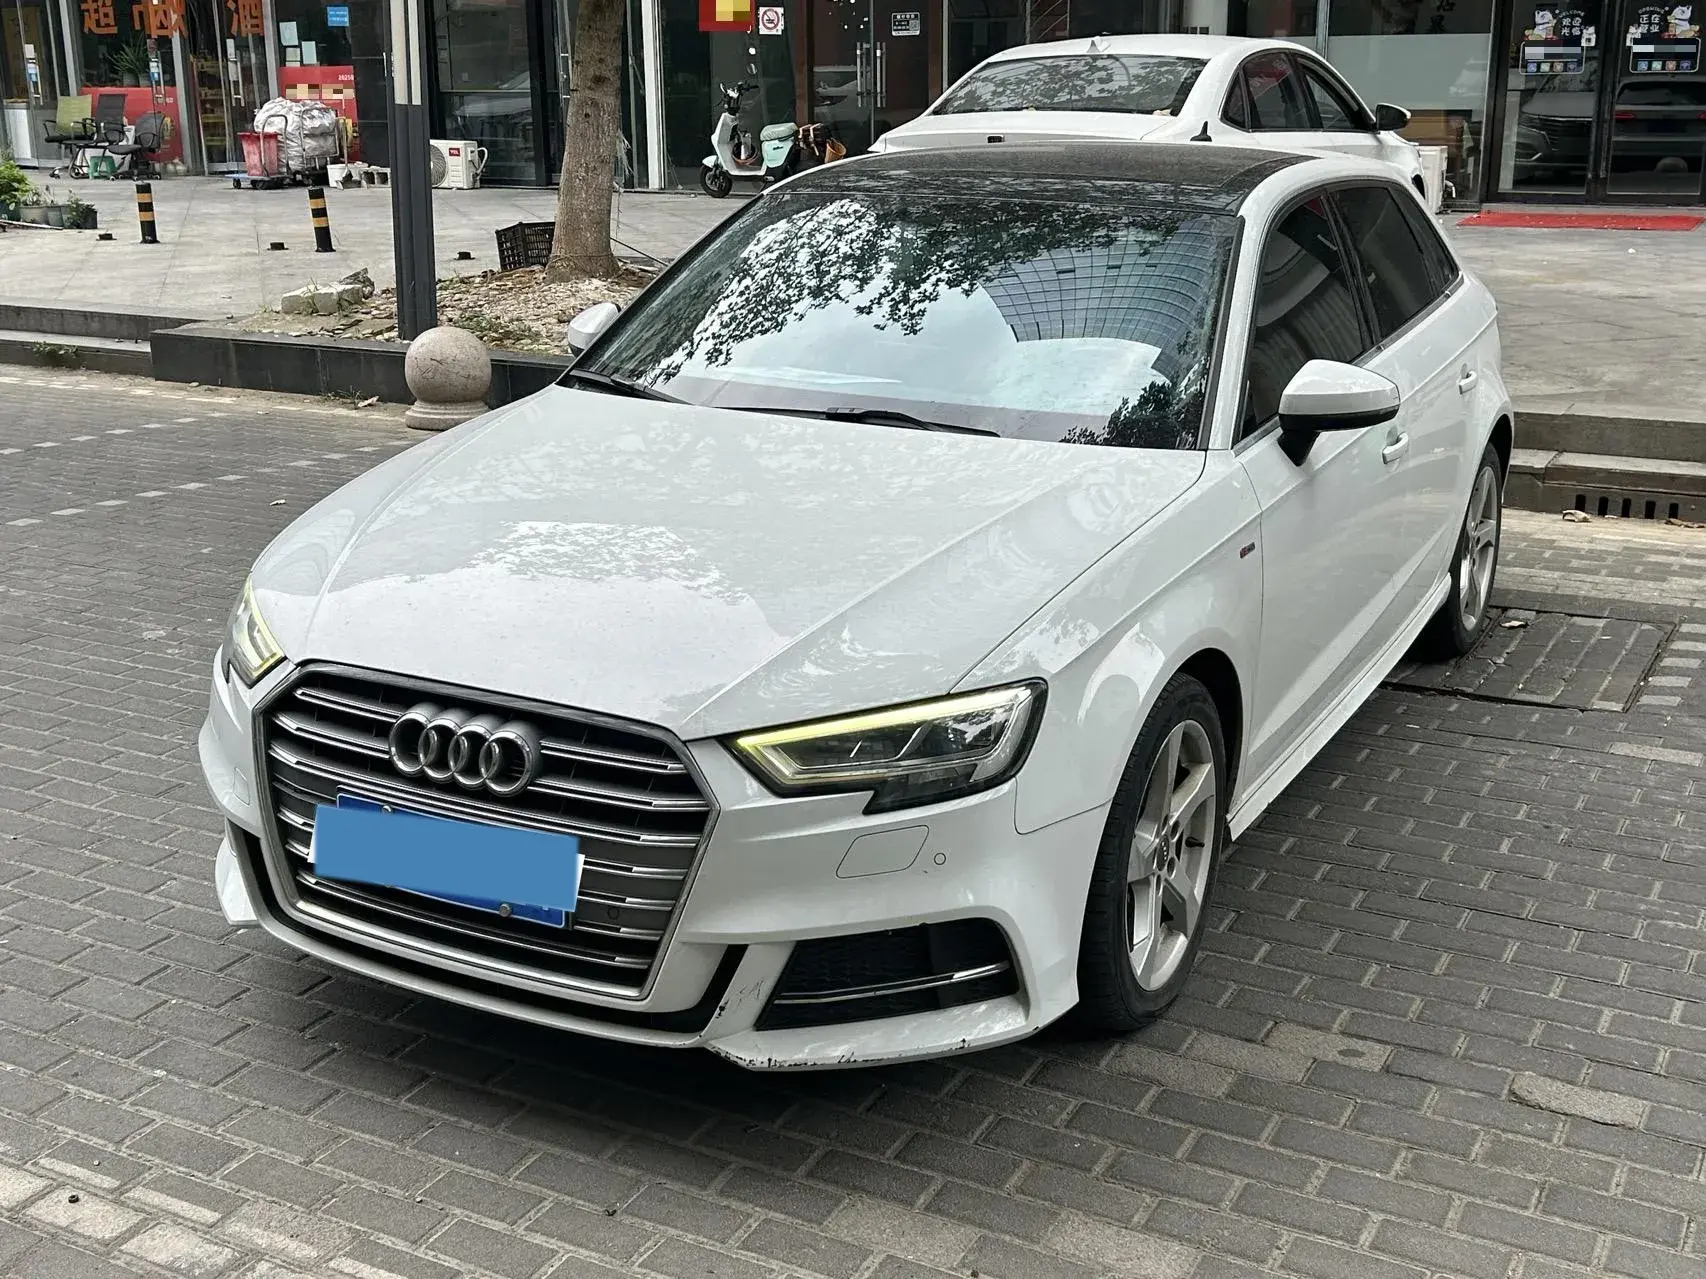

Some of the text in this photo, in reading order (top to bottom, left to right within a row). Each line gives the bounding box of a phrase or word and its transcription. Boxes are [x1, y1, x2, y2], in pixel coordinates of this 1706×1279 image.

[80, 0, 118, 34] 超
[226, 0, 264, 38] 酒
[1639, 14, 1661, 23] 正在
